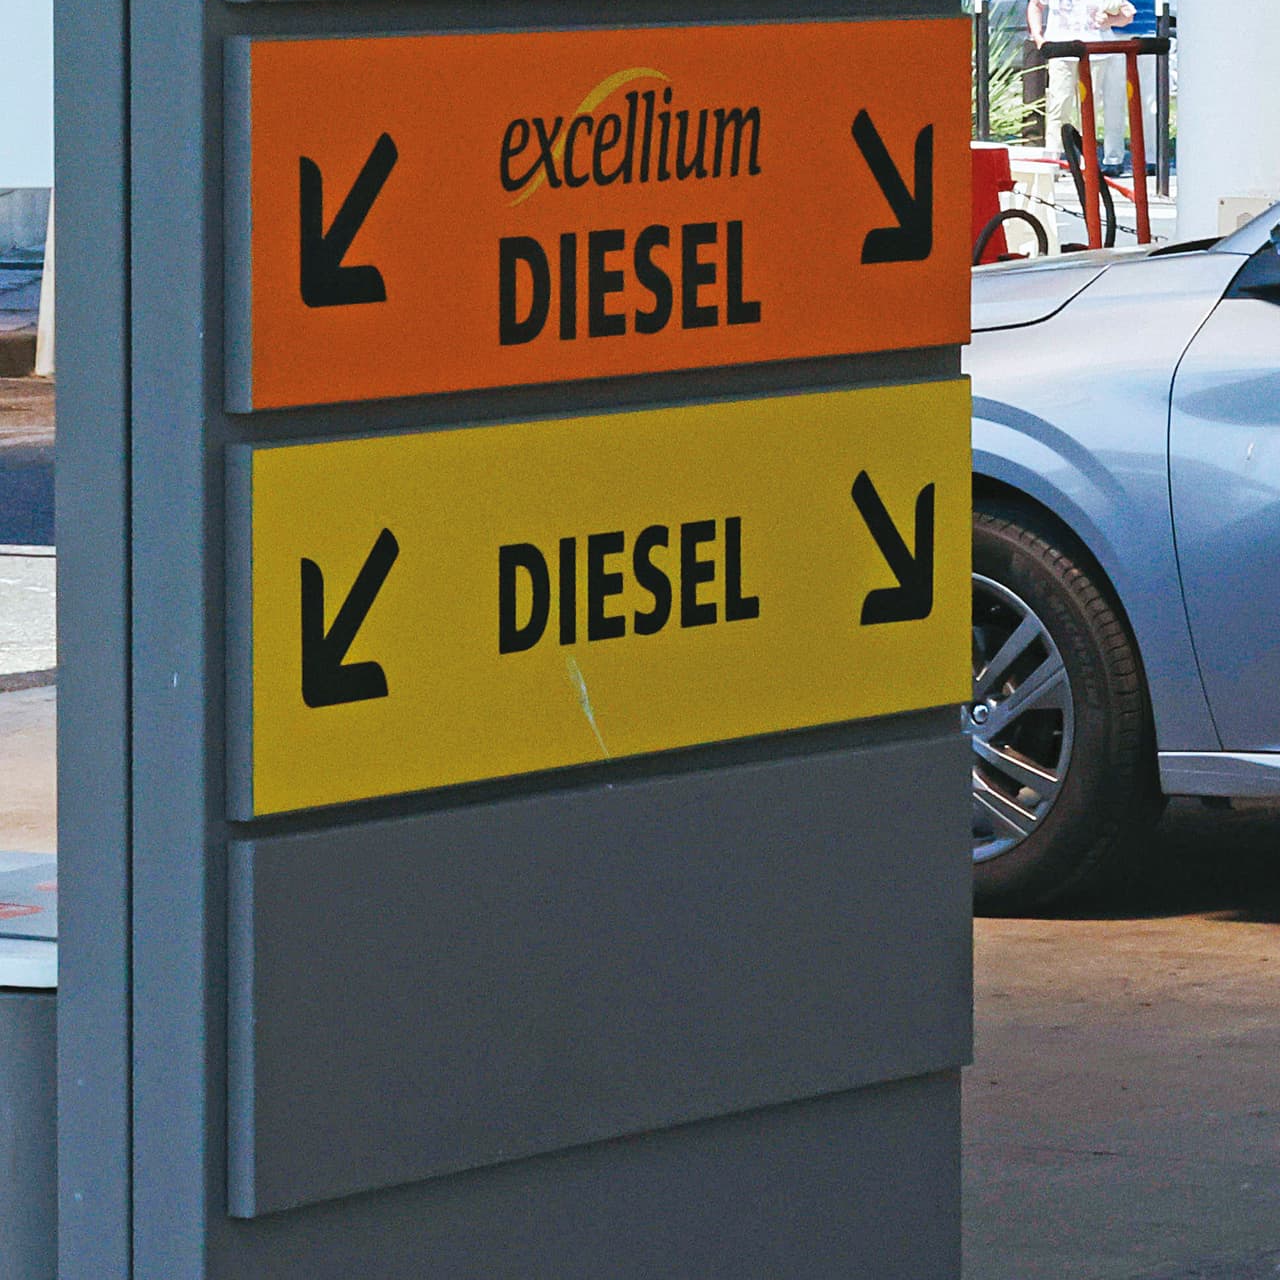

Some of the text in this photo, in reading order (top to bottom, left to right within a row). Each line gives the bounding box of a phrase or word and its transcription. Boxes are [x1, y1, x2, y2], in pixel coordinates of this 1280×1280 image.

[500, 87, 762, 193] excellium
[499, 220, 762, 347] DIESEL
[499, 516, 760, 654] DIESEL
